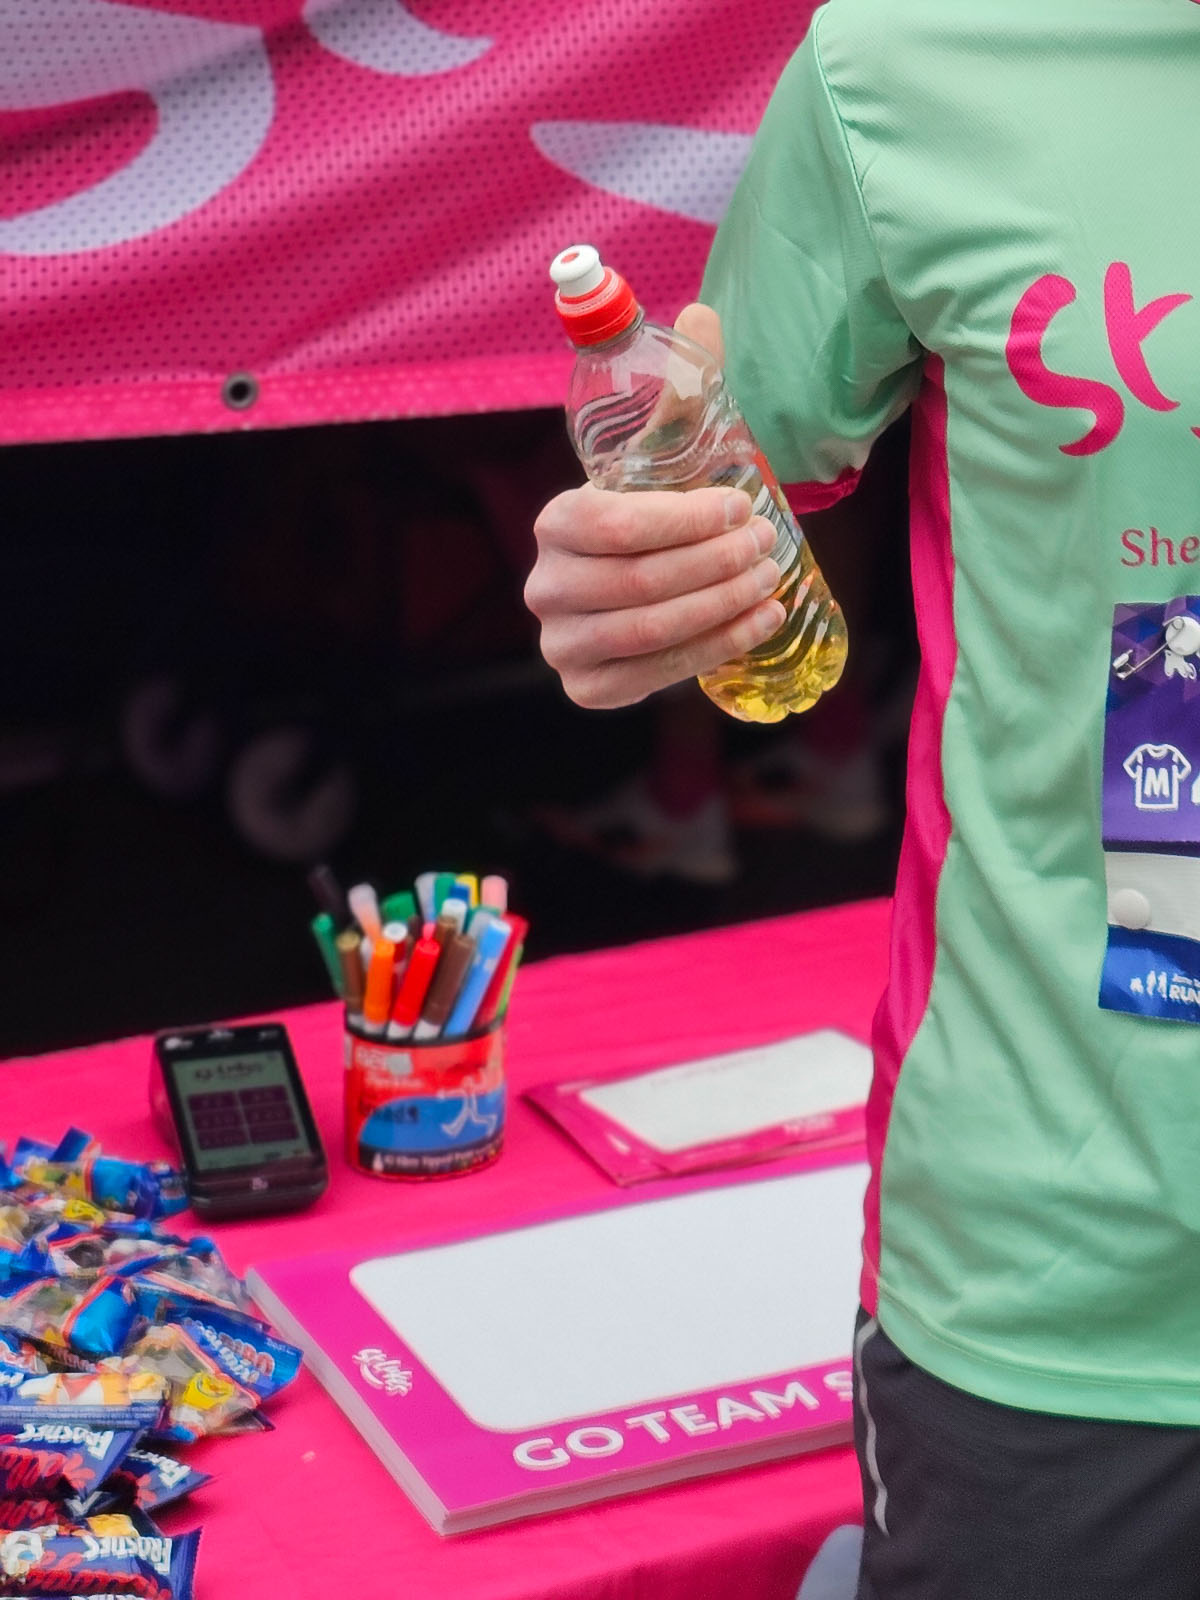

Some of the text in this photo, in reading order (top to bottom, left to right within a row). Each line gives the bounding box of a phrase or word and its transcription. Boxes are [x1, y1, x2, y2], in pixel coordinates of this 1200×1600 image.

[1005, 261, 1193, 457] St
[1144, 766, 1170, 798] M
[513, 1369, 853, 1471] GO TEAM S
